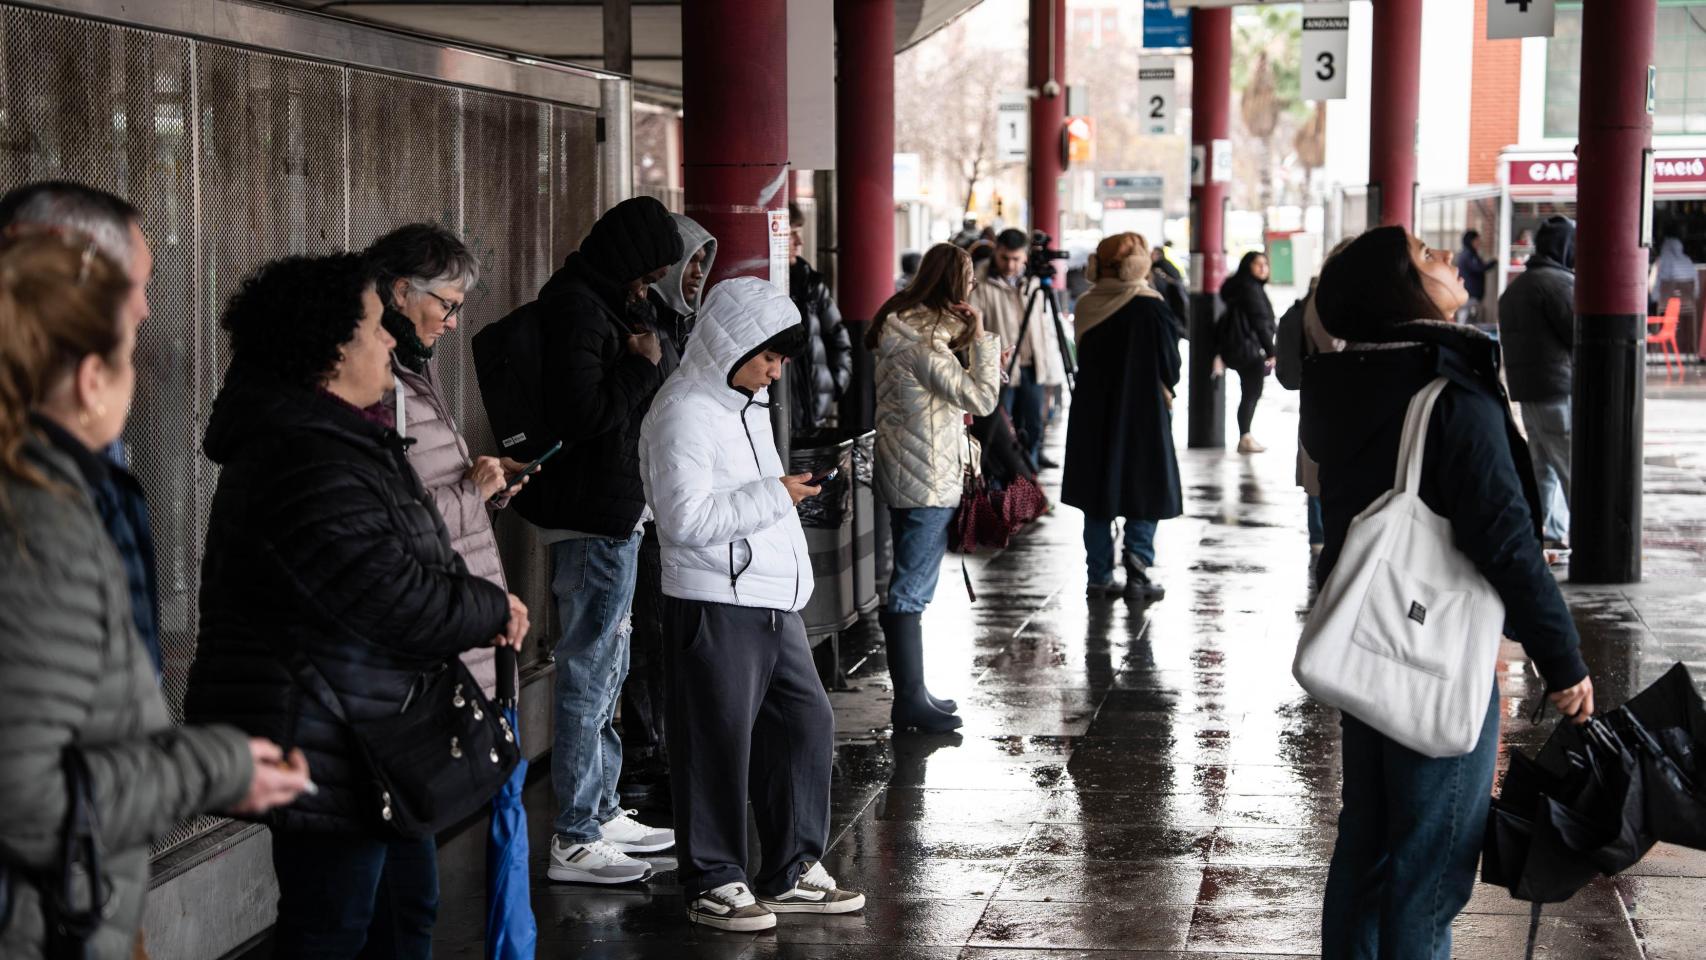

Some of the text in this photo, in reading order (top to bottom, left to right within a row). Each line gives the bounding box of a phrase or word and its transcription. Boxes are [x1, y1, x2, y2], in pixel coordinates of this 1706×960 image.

[1304, 19, 1348, 28] ANDANA
[1316, 51, 1336, 81] 3
[1150, 95, 1165, 118] 2
[1009, 121, 1017, 139] 1
[1528, 158, 1705, 182] CAF TACIÓ
